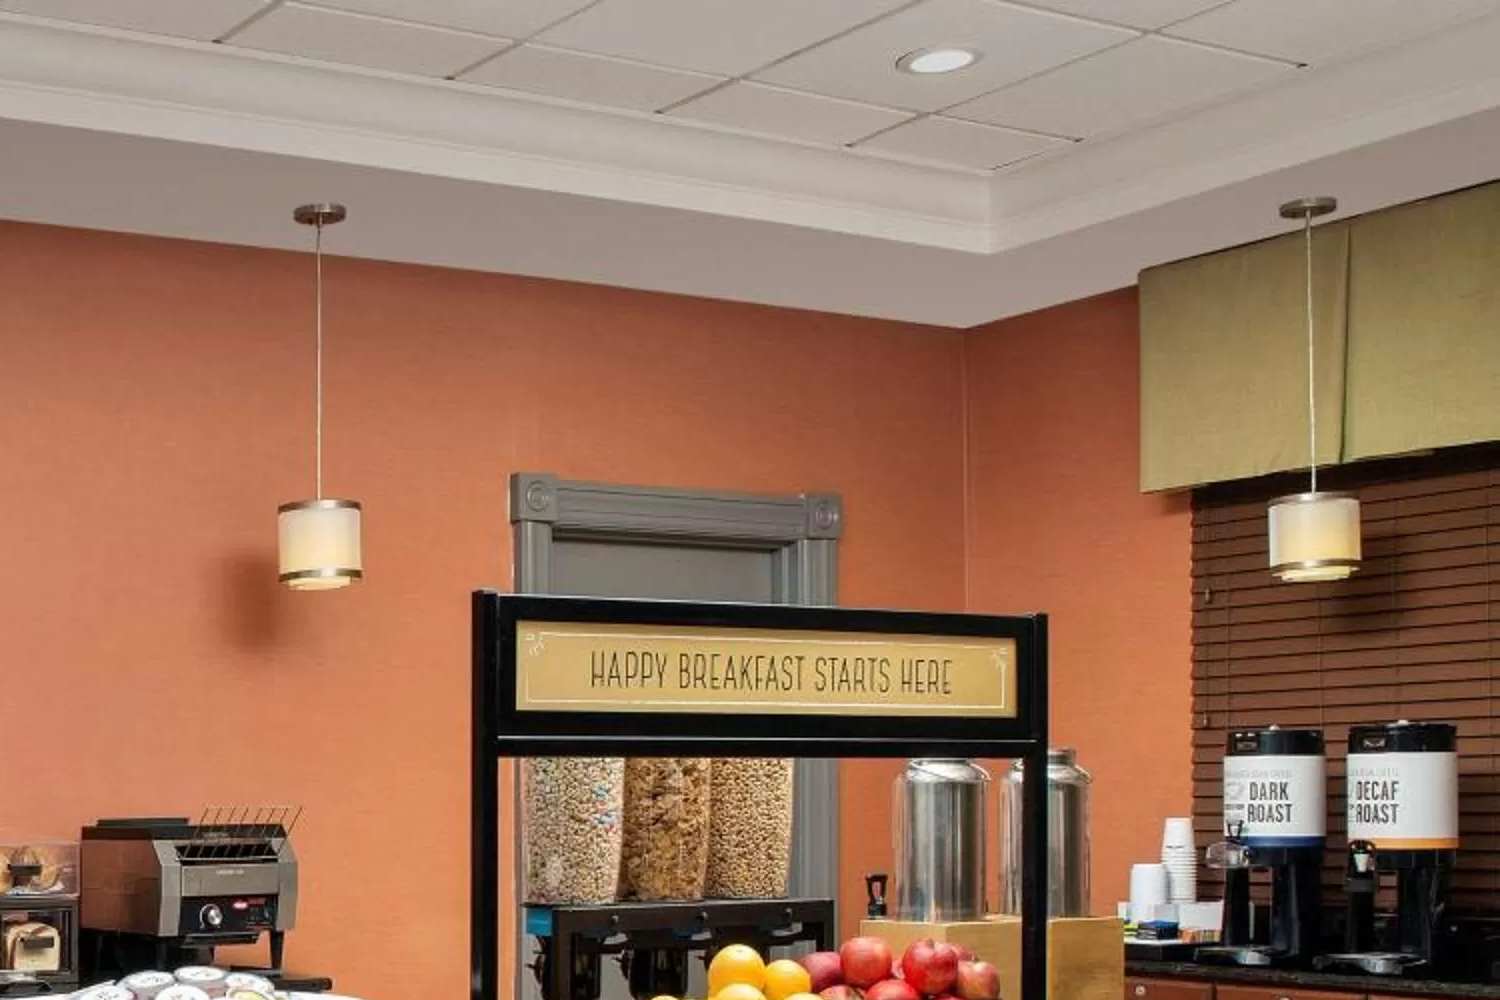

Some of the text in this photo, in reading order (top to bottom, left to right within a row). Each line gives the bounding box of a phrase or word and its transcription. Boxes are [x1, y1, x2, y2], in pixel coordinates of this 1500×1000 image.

[591, 650, 953, 695] HAPPY BREAKFAST STARTS HERE
[1249, 781, 1289, 801] DARK
[1355, 780, 1400, 801] DECAF
[1247, 803, 1293, 823] ROAST
[1355, 803, 1400, 824] ROAST
